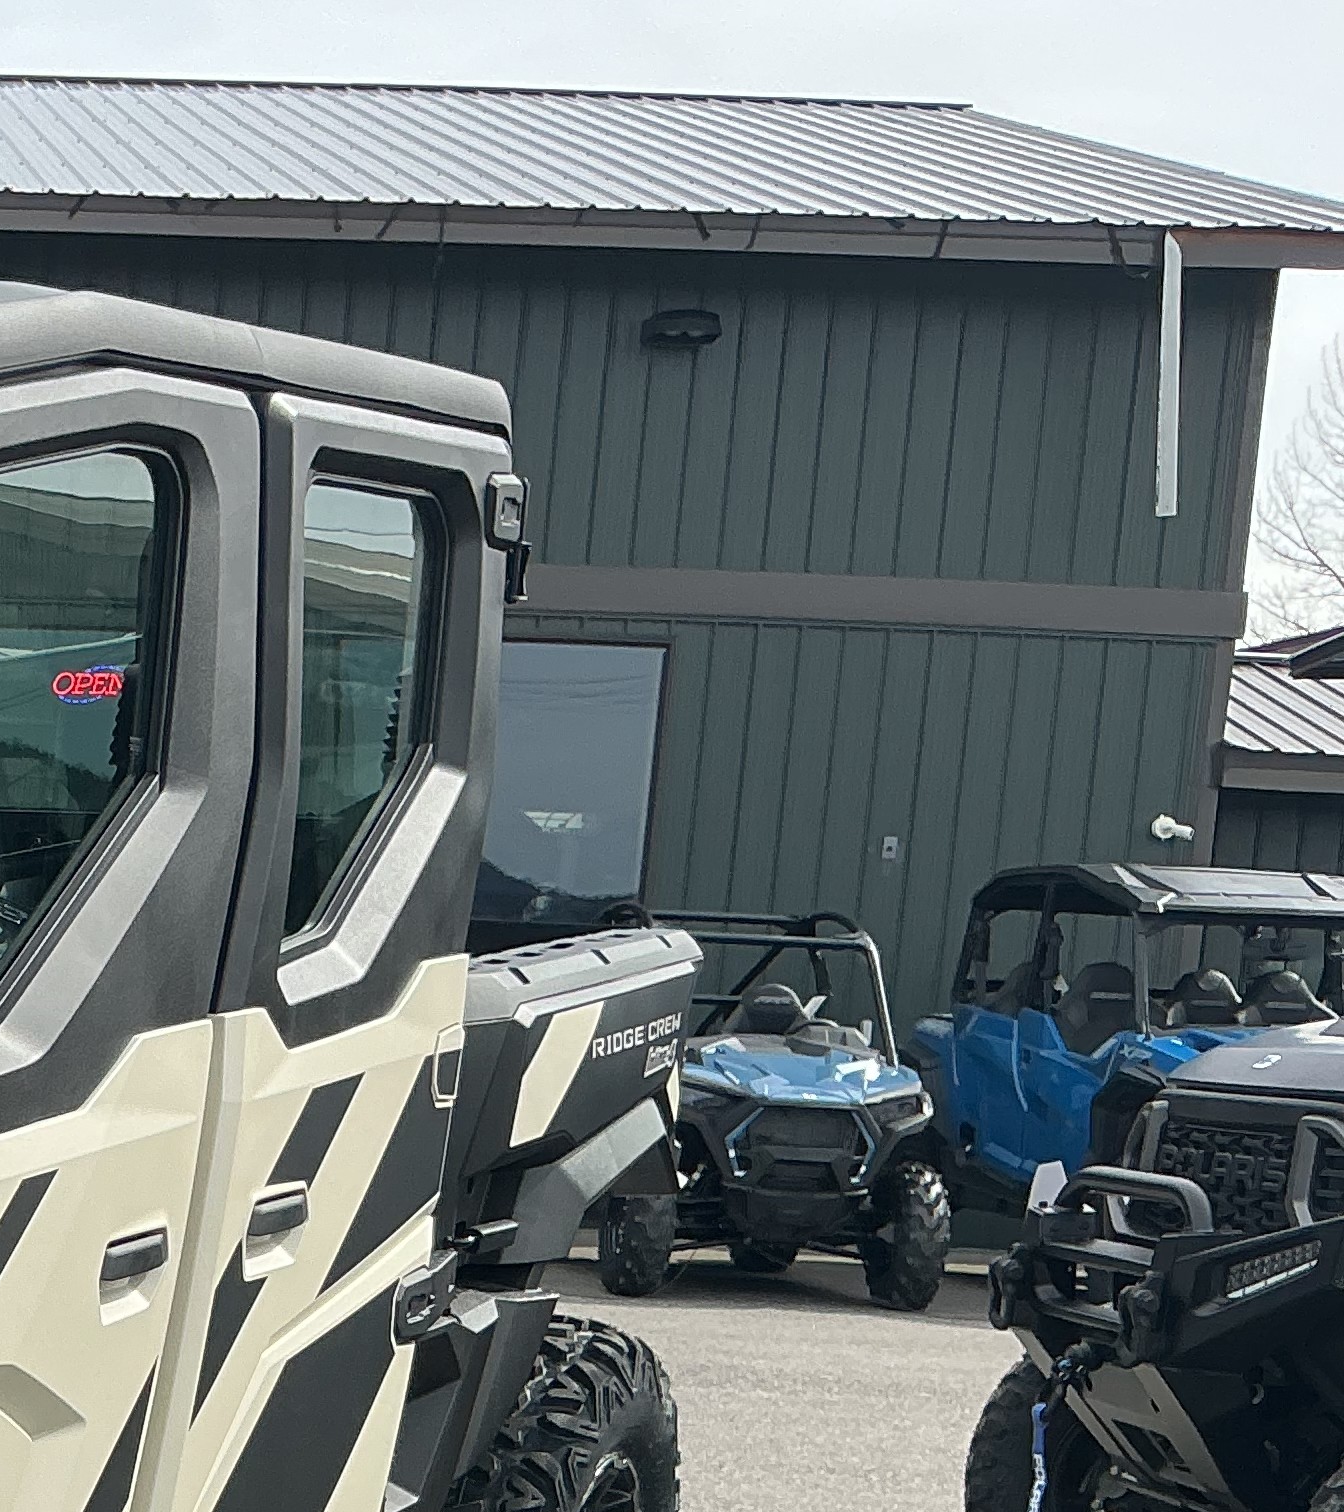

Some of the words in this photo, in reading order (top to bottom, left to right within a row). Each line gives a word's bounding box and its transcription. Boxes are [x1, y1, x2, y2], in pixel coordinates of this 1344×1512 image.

[52, 671, 123, 695] OPEN
[592, 1024, 645, 1059] RIDGE
[647, 1012, 682, 1042] CREW
